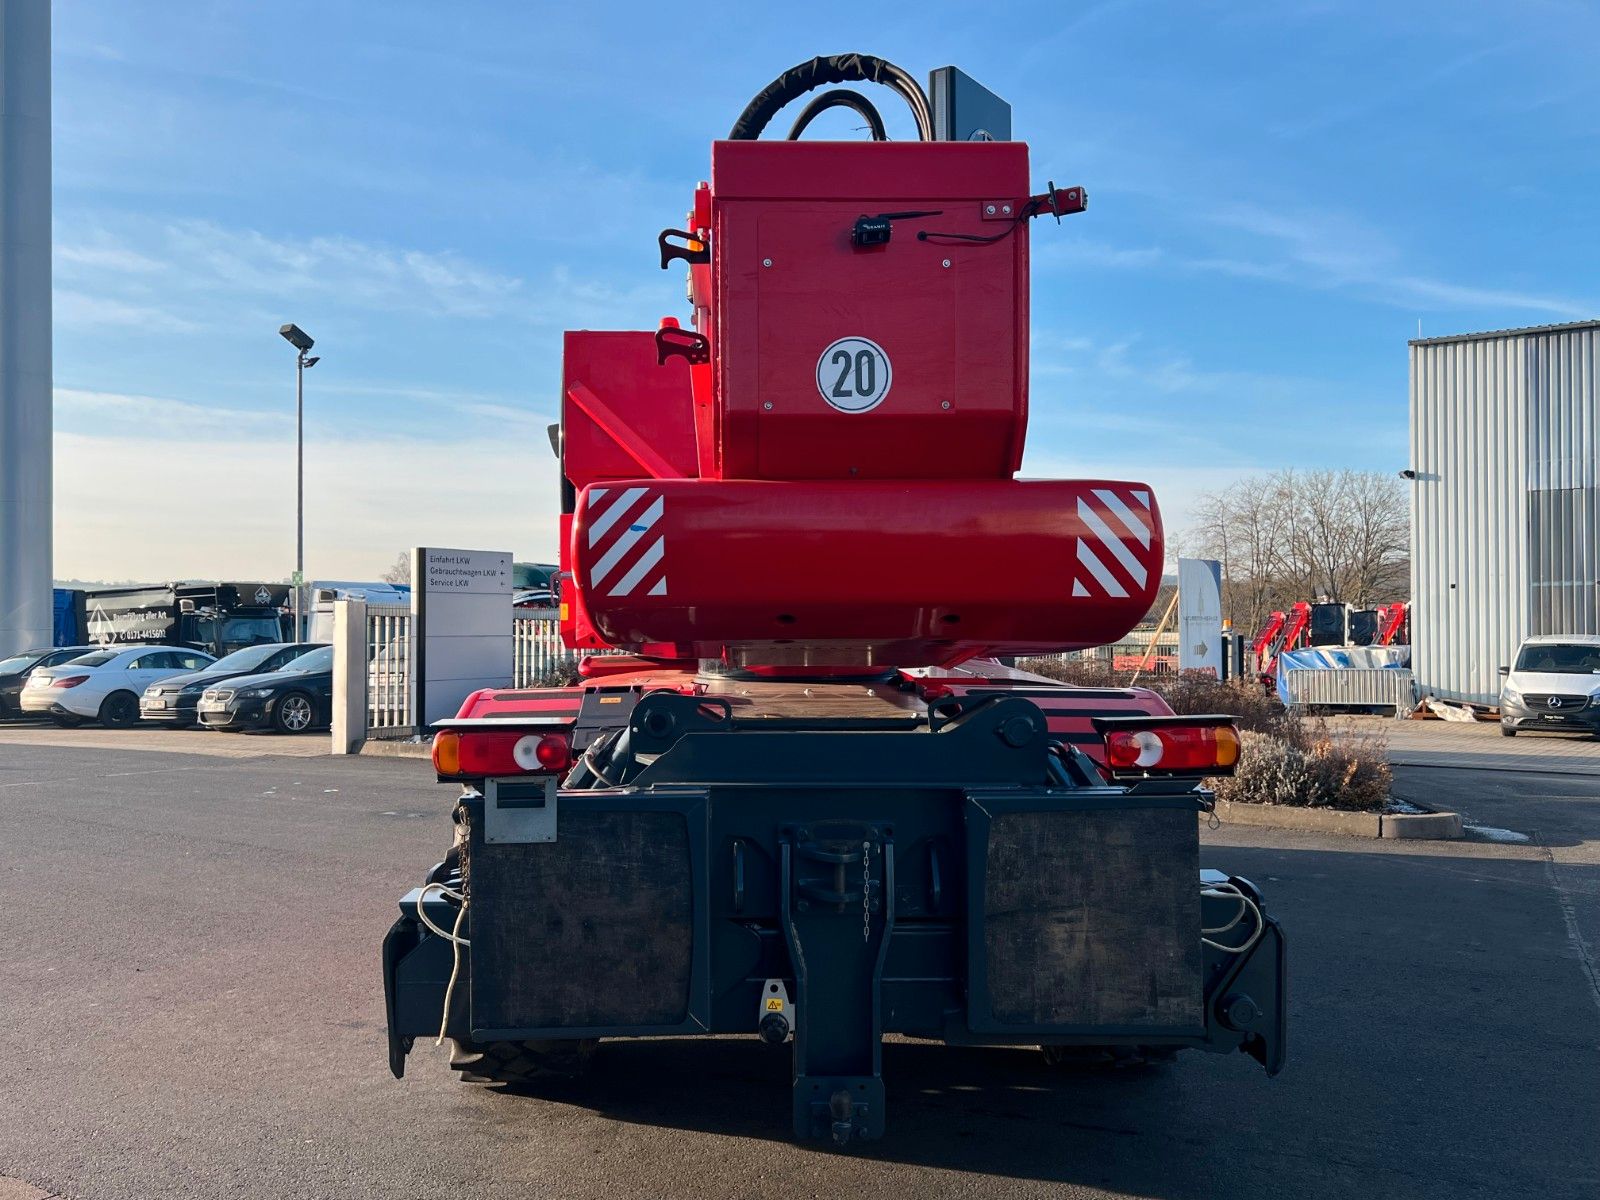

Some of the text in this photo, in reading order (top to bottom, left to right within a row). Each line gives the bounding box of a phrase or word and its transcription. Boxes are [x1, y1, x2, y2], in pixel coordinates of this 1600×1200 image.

[831, 349, 875, 397] 20
[430, 556, 471, 565] Einfahrt LKW
[430, 567, 481, 577] Gebrauchtwagen
[430, 579, 454, 587] Service
[158, 610, 167, 619] Art
